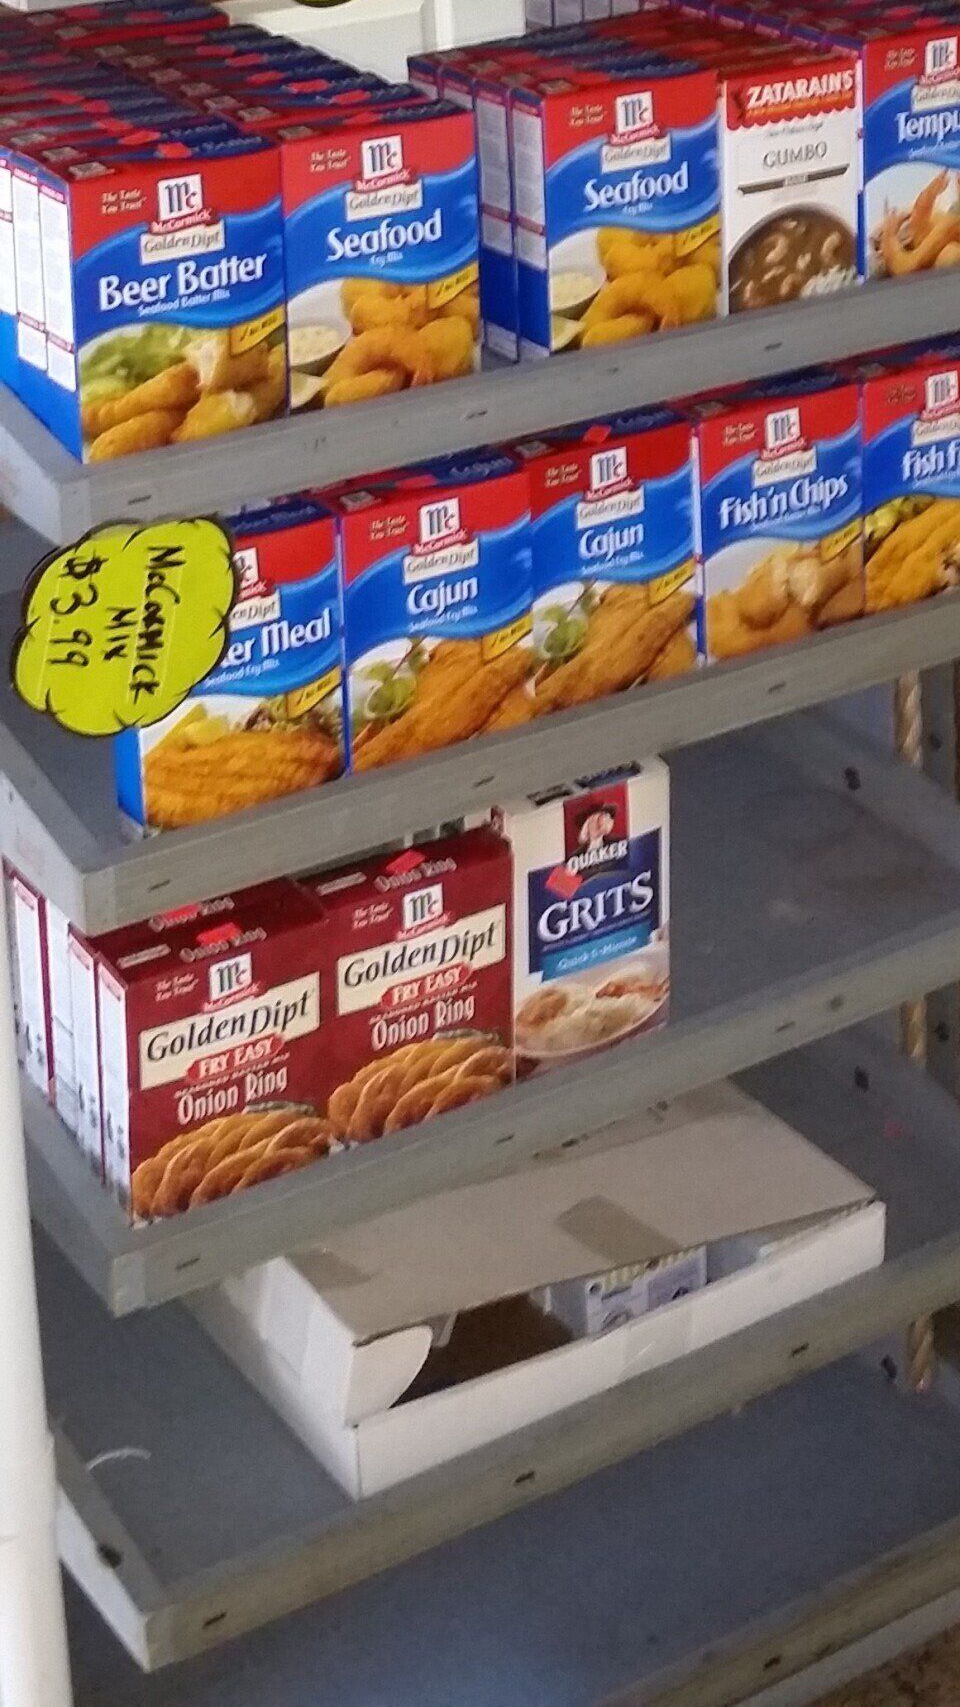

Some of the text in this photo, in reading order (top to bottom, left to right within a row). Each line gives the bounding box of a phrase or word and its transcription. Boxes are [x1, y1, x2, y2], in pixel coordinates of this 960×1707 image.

[747, 69, 855, 110] ZATARAIN'S
[763, 140, 828, 169] GUMBO
[356, 167, 411, 191] McCormick
[583, 160, 689, 213] Seafood
[151, 208, 212, 233] McCormick
[326, 207, 443, 263] Seafood
[99, 253, 267, 312] Beer Batter
[902, 444, 945, 482] Fish
[788, 473, 849, 512] Chips
[578, 522, 645, 563] Cajun
[406, 576, 479, 617] Cajun
[261, 607, 331, 654] Meal
[566, 839, 629, 876] QUAKER
[536, 870, 654, 943] GRITS
[391, 965, 462, 1006] FRY EASY
[371, 994, 476, 1052] Onion Ring
[200, 1052, 230, 1077] FRY
[233, 1036, 274, 1067] EASY
[176, 1084, 239, 1126] Onion
[244, 1066, 288, 1103] Ring
